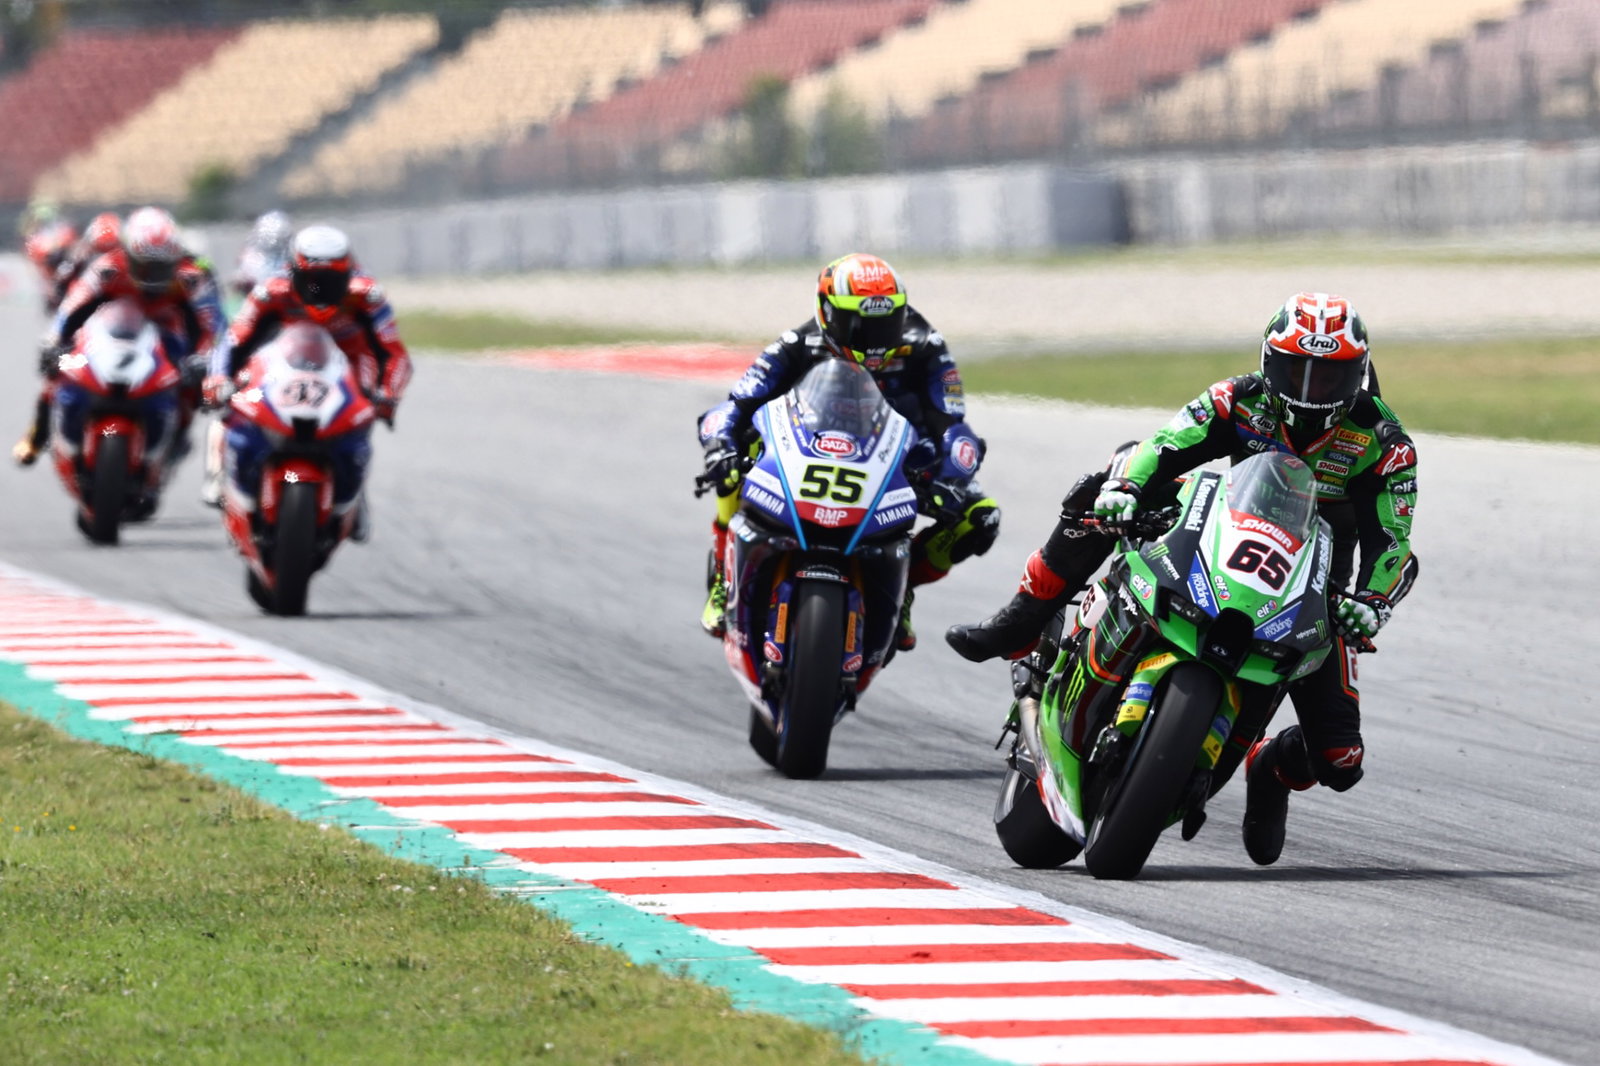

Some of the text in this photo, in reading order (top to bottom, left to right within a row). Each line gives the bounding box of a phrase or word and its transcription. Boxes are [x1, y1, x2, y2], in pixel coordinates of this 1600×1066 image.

[853, 266, 889, 280] BMP
[861, 298, 892, 310] Airoh
[1301, 335, 1335, 349] Arai
[1279, 391, 1344, 410] www.jonathan-rea.com
[1251, 416, 1275, 430] Arai
[820, 440, 848, 452] PATA
[1247, 439, 1268, 452] elf
[1318, 461, 1349, 474] SHOWA
[799, 464, 868, 504] 55
[745, 484, 785, 516] YAMAHA
[1184, 477, 1218, 532] Kawasaki
[813, 507, 848, 520] BMP
[874, 503, 915, 526] YAMAHA
[1241, 518, 1293, 549] SHOWA
[1226, 539, 1292, 591] 65
[1311, 530, 1330, 595] Kawasaki
[1132, 574, 1148, 591] elf
[1214, 575, 1228, 594] elf
[1256, 603, 1270, 618] elf
